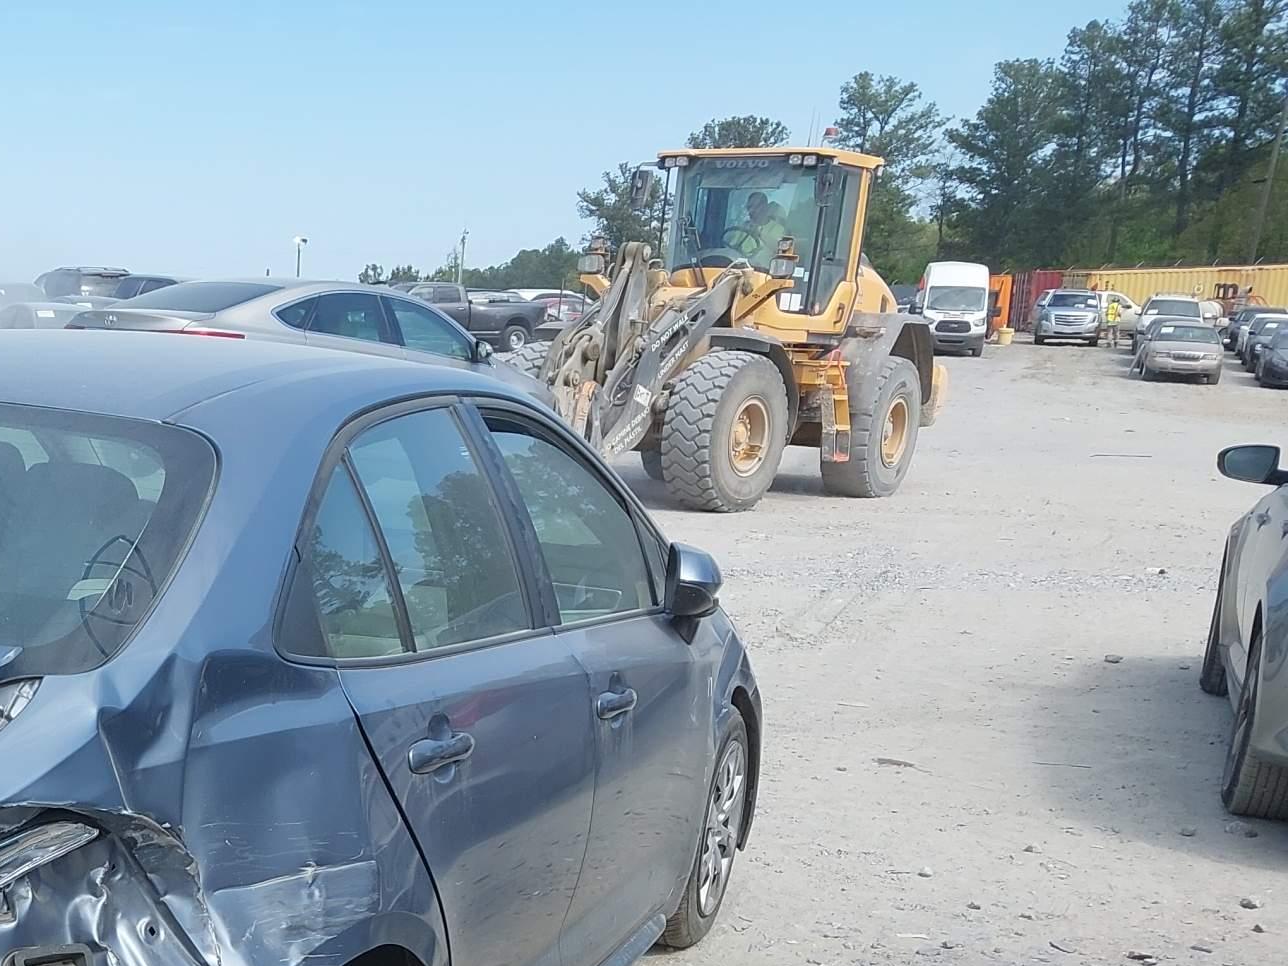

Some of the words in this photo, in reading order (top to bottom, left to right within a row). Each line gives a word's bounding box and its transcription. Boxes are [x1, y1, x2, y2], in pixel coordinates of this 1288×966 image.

[715, 159, 769, 169] VOLVO
[651, 340, 661, 352] DO
[660, 327, 673, 344] NOT
[672, 313, 689, 330] WALK
